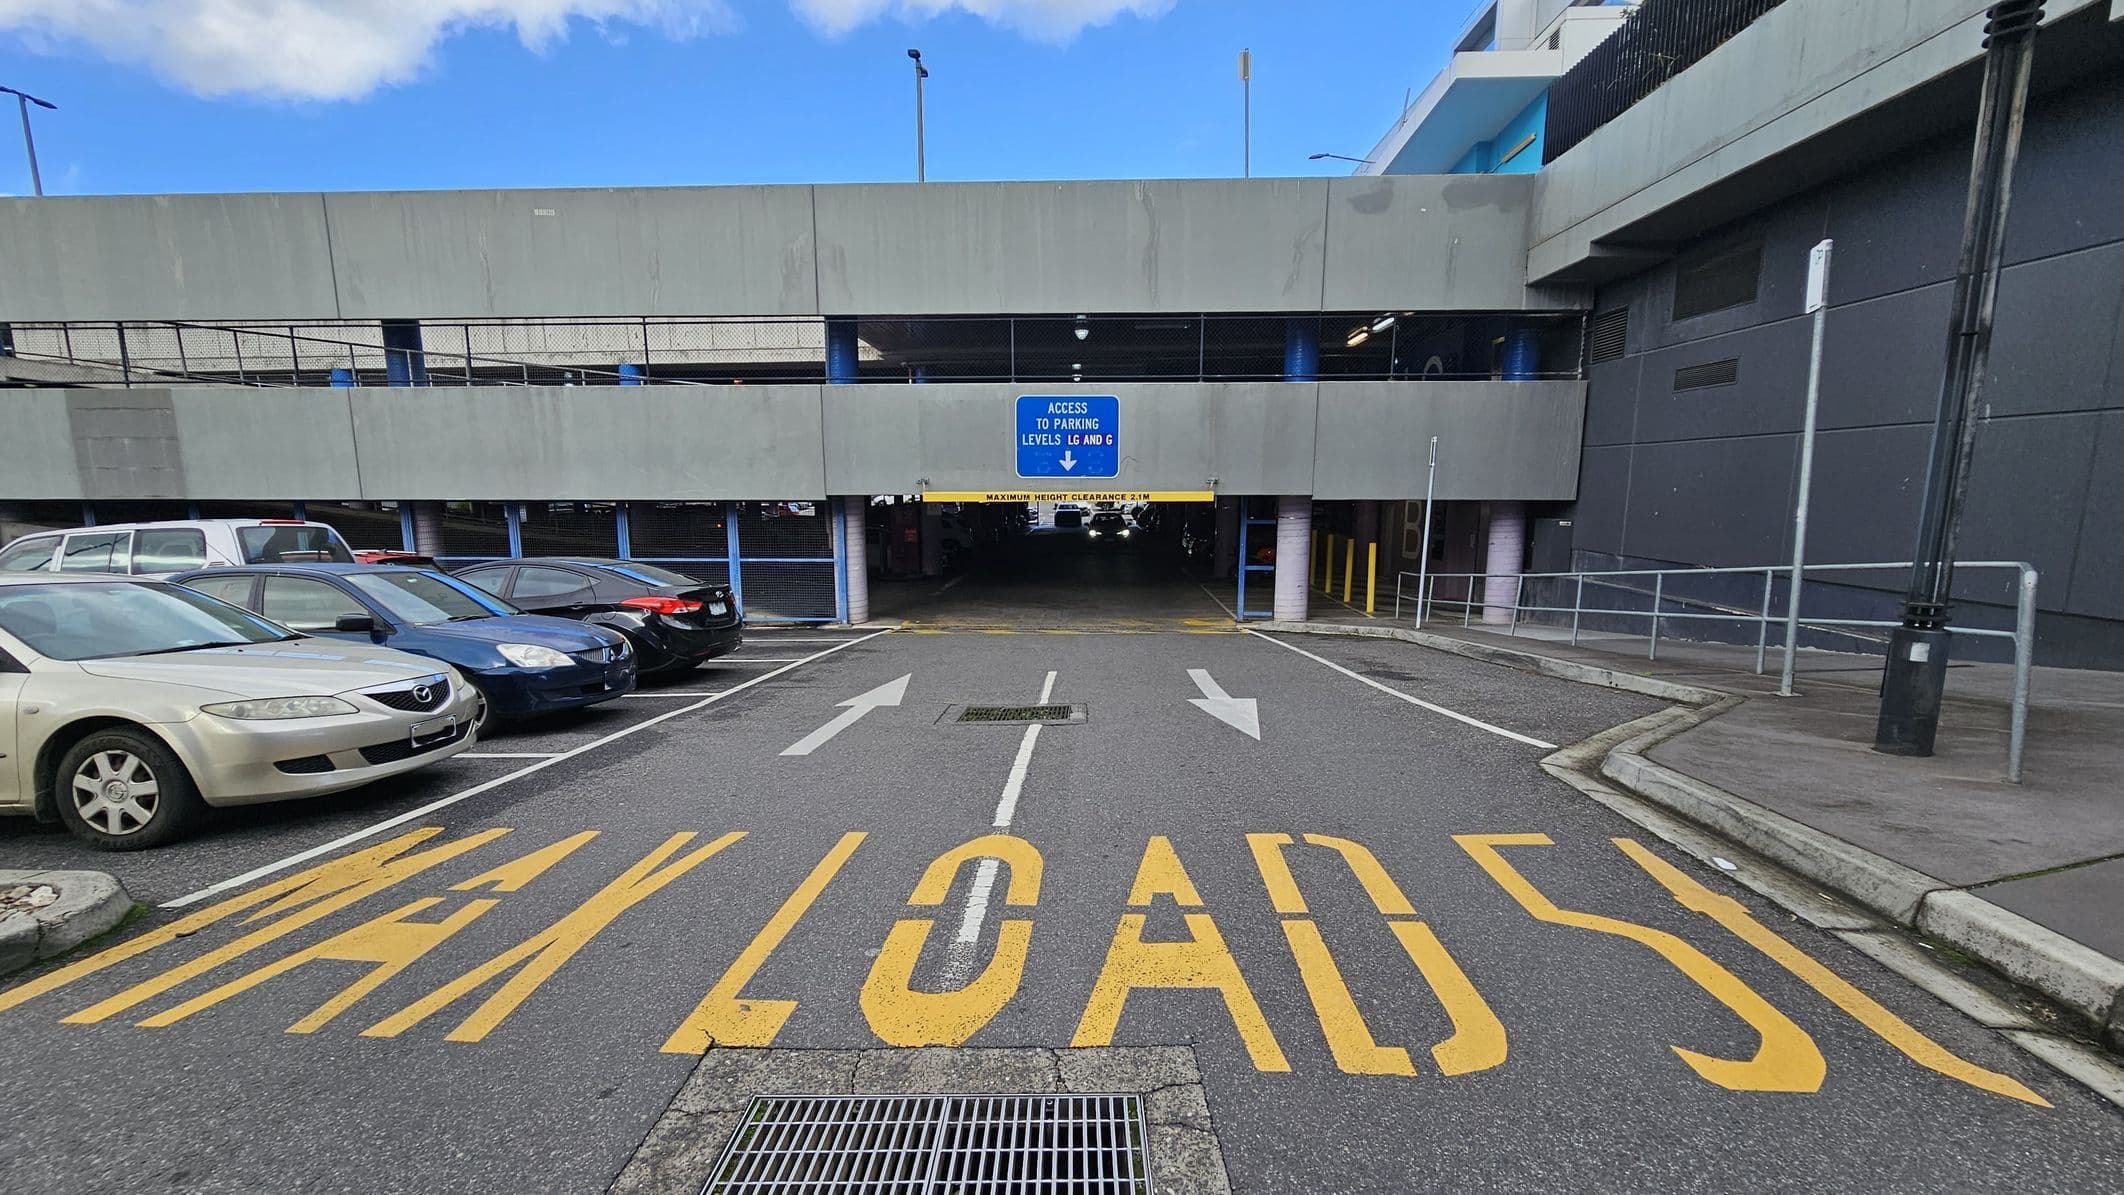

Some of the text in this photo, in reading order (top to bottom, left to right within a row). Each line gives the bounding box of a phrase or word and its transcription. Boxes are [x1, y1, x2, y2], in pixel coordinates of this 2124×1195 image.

[1048, 402, 1088, 414] ACCESS
[1036, 418, 1099, 430] TO PARKING
[1022, 434, 1113, 446] LEVELS LG AND G
[986, 493, 1150, 501] MAXIMUM HEIGHT CLEARANCE 2.1M
[660, 832, 1508, 1077] LOAD
